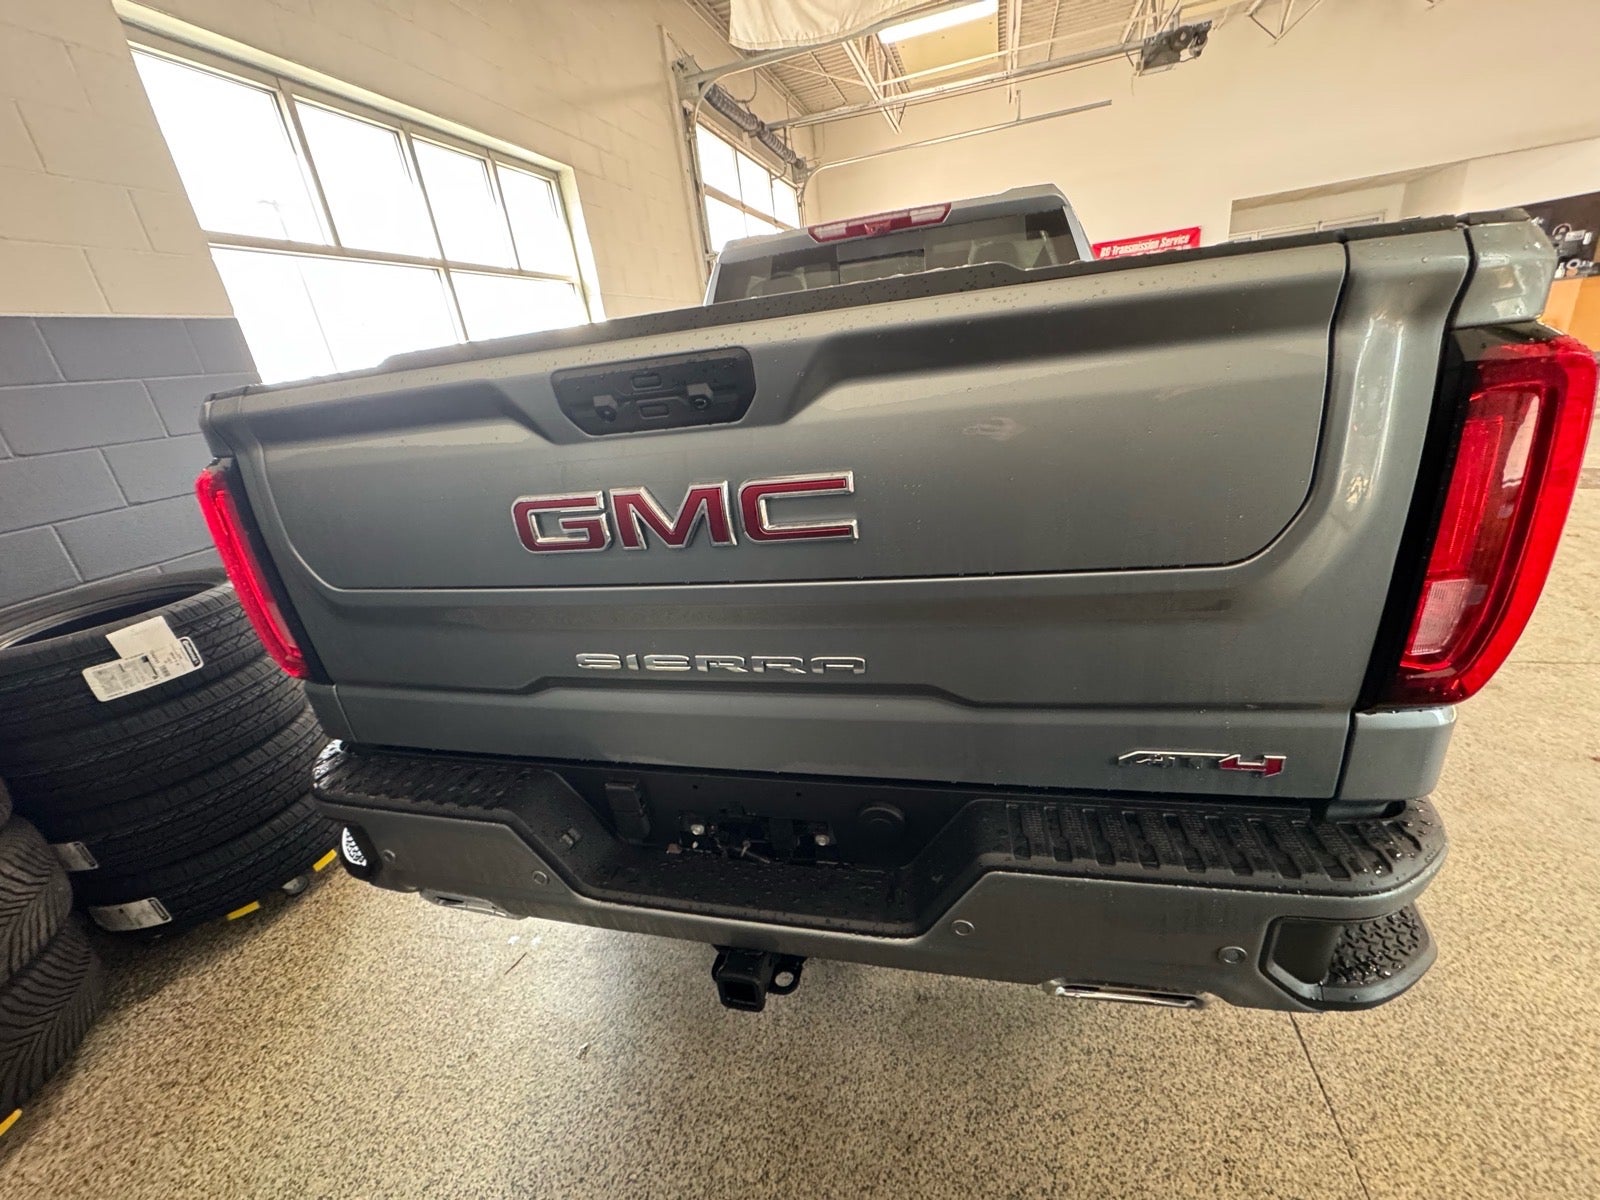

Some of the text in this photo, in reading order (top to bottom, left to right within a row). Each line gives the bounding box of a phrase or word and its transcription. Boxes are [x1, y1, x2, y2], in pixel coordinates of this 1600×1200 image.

[1112, 240, 1159, 254] Transmission
[1161, 235, 1190, 247] Service
[511, 470, 859, 553] GMC
[575, 652, 867, 675] SIERRA
[1117, 750, 1287, 778] AT4
